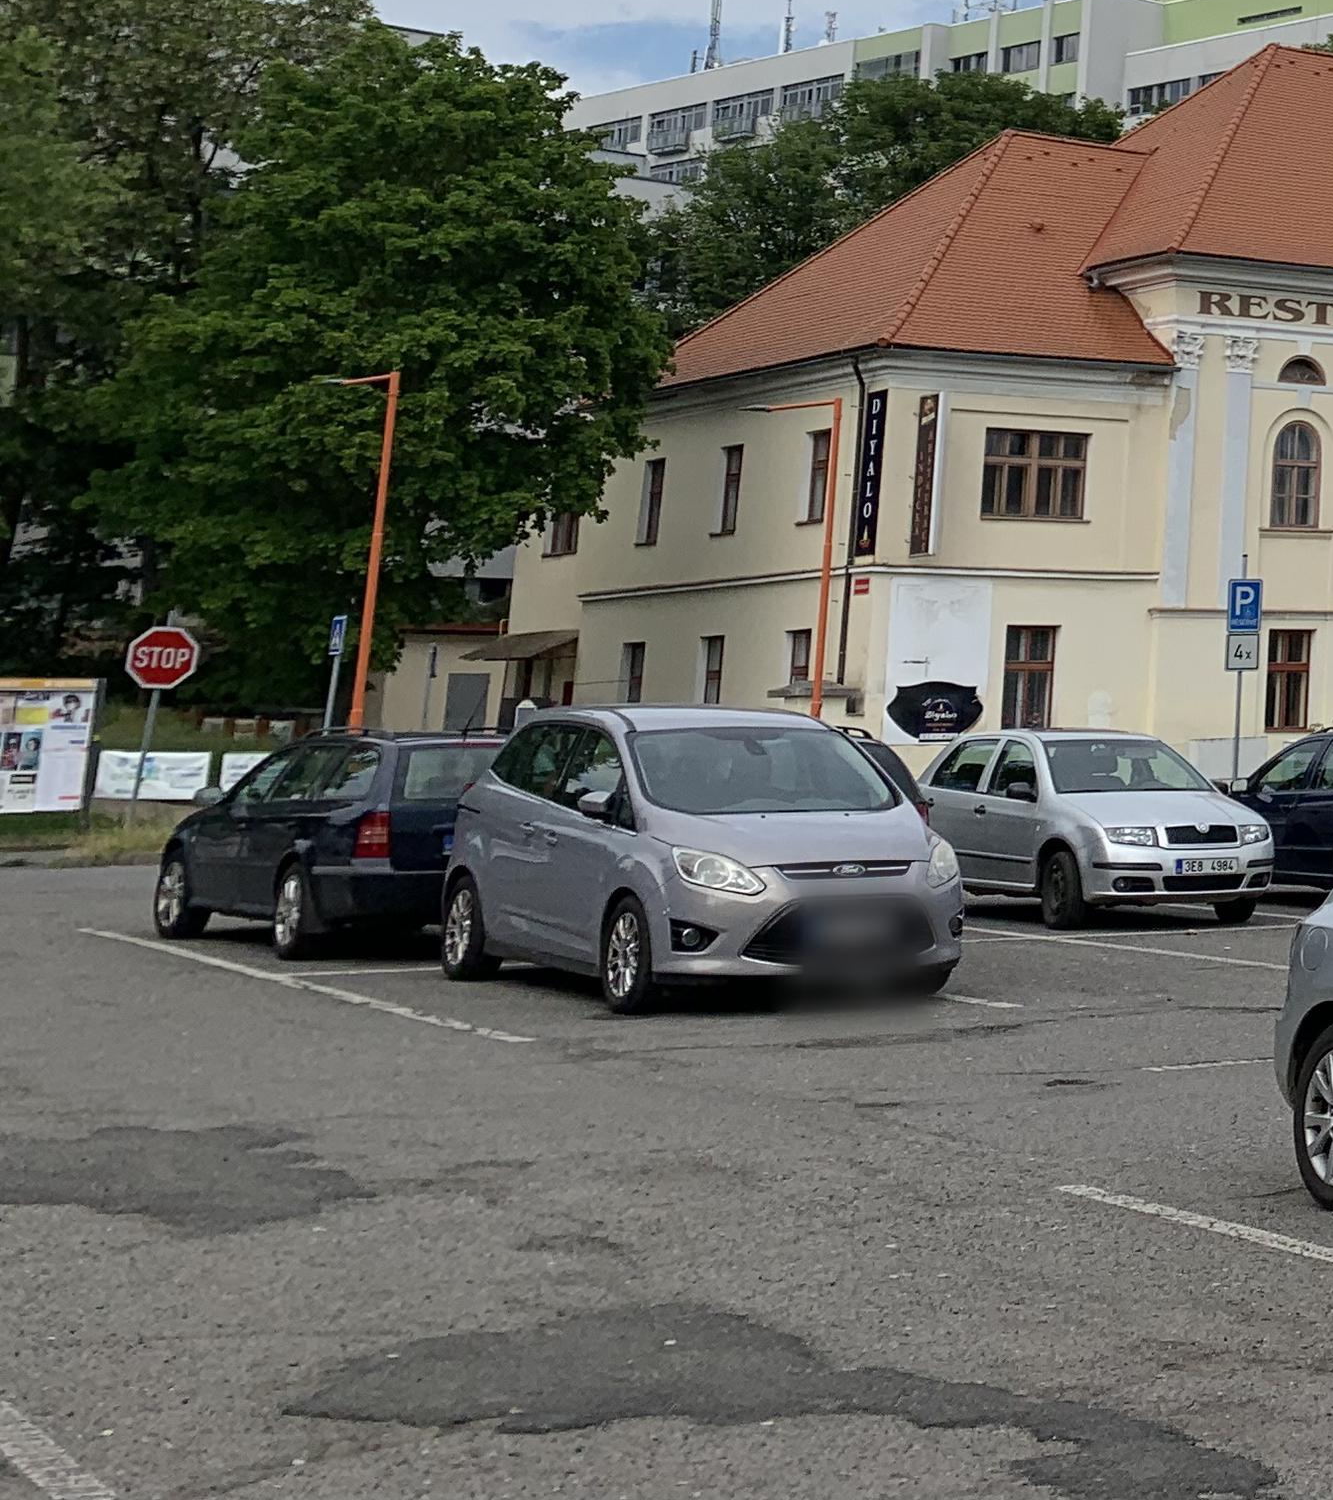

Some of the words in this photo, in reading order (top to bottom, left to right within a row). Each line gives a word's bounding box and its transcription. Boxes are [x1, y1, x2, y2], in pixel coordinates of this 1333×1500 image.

[862, 398, 881, 519] DIYALO
[1235, 586, 1255, 616] P
[134, 645, 191, 670] STOP
[1184, 861, 1204, 873] 3E8
[1210, 859, 1234, 872] 4984
